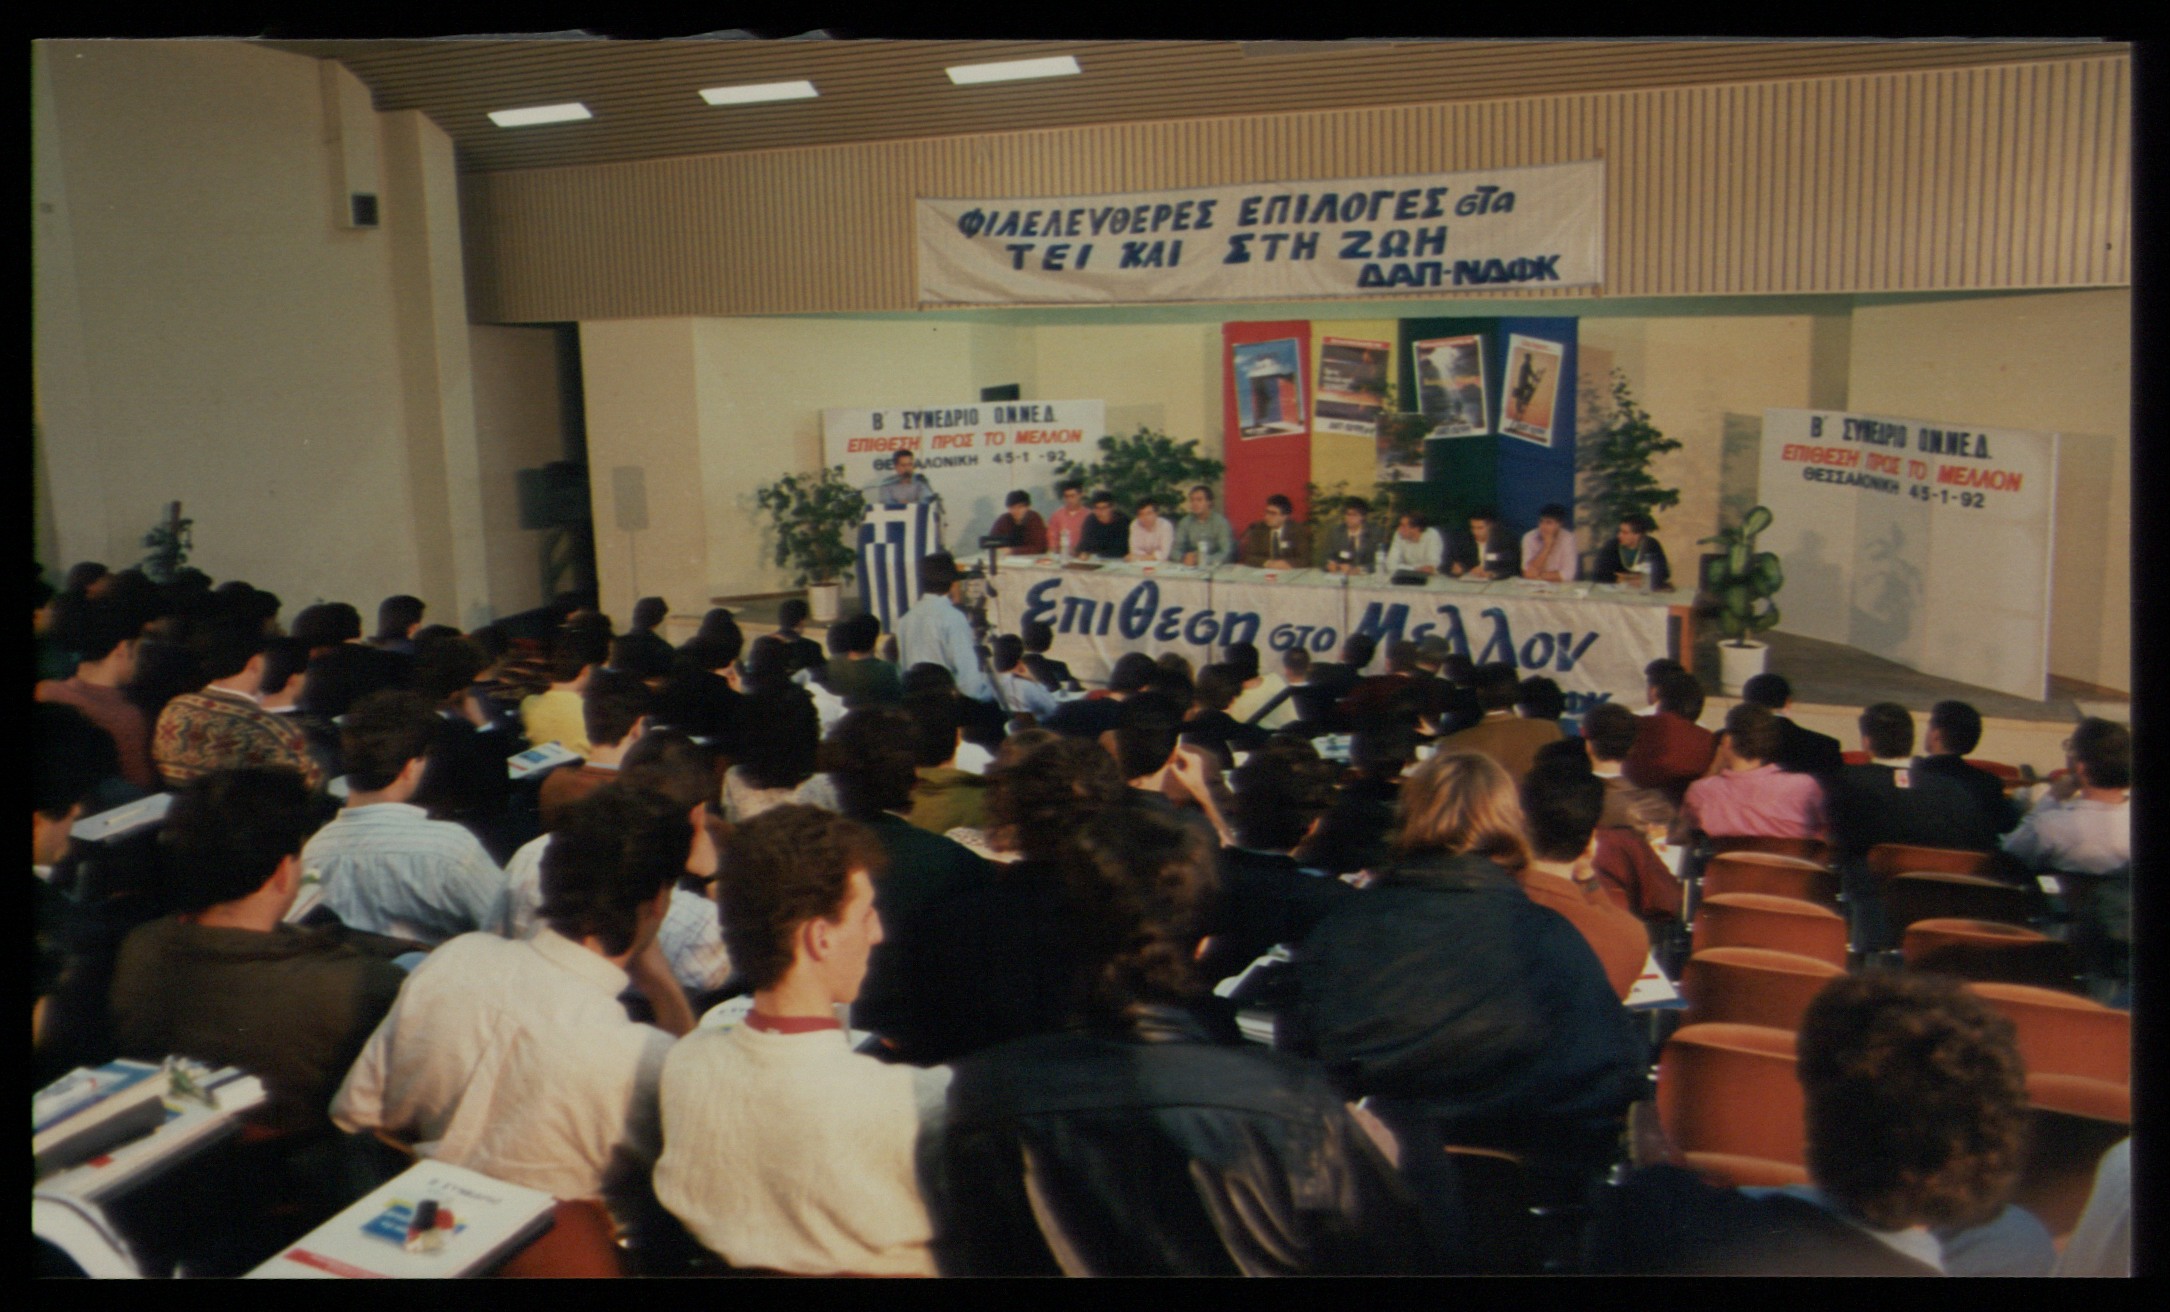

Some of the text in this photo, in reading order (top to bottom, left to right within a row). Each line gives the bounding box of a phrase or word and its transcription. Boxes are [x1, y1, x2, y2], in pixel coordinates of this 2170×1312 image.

[957, 199, 1218, 239] ΦΙΛΕΛΕΥΘΕΡΕΣ
[1237, 186, 1449, 227] ΕΠΙΛΟΓΕΣ
[1005, 225, 1448, 271] ΤΕΙ ΚΑΙ ΣΤΗ ΖΩΗ
[1357, 254, 1562, 288] ΔΑΠ-ΝΔΦΚ
[902, 408, 979, 431] ΣΥΝΕΔΡΙΟ
[1843, 417, 1908, 449] ΣΥΝΕΔΡΙΟ
[846, 429, 1083, 454] ΕΠΙΘΕΣΗ ΠΡΟΣ ΤΟ ΜΕΛΛΟΝ
[873, 454, 978, 472] ΘΕΑΛΟΝΙΚΗ
[1781, 443, 2023, 493] ΕΠΙΘΕΣΗ ΠΡΟΣ ΤΟ ΜΕΛΛΟΝ
